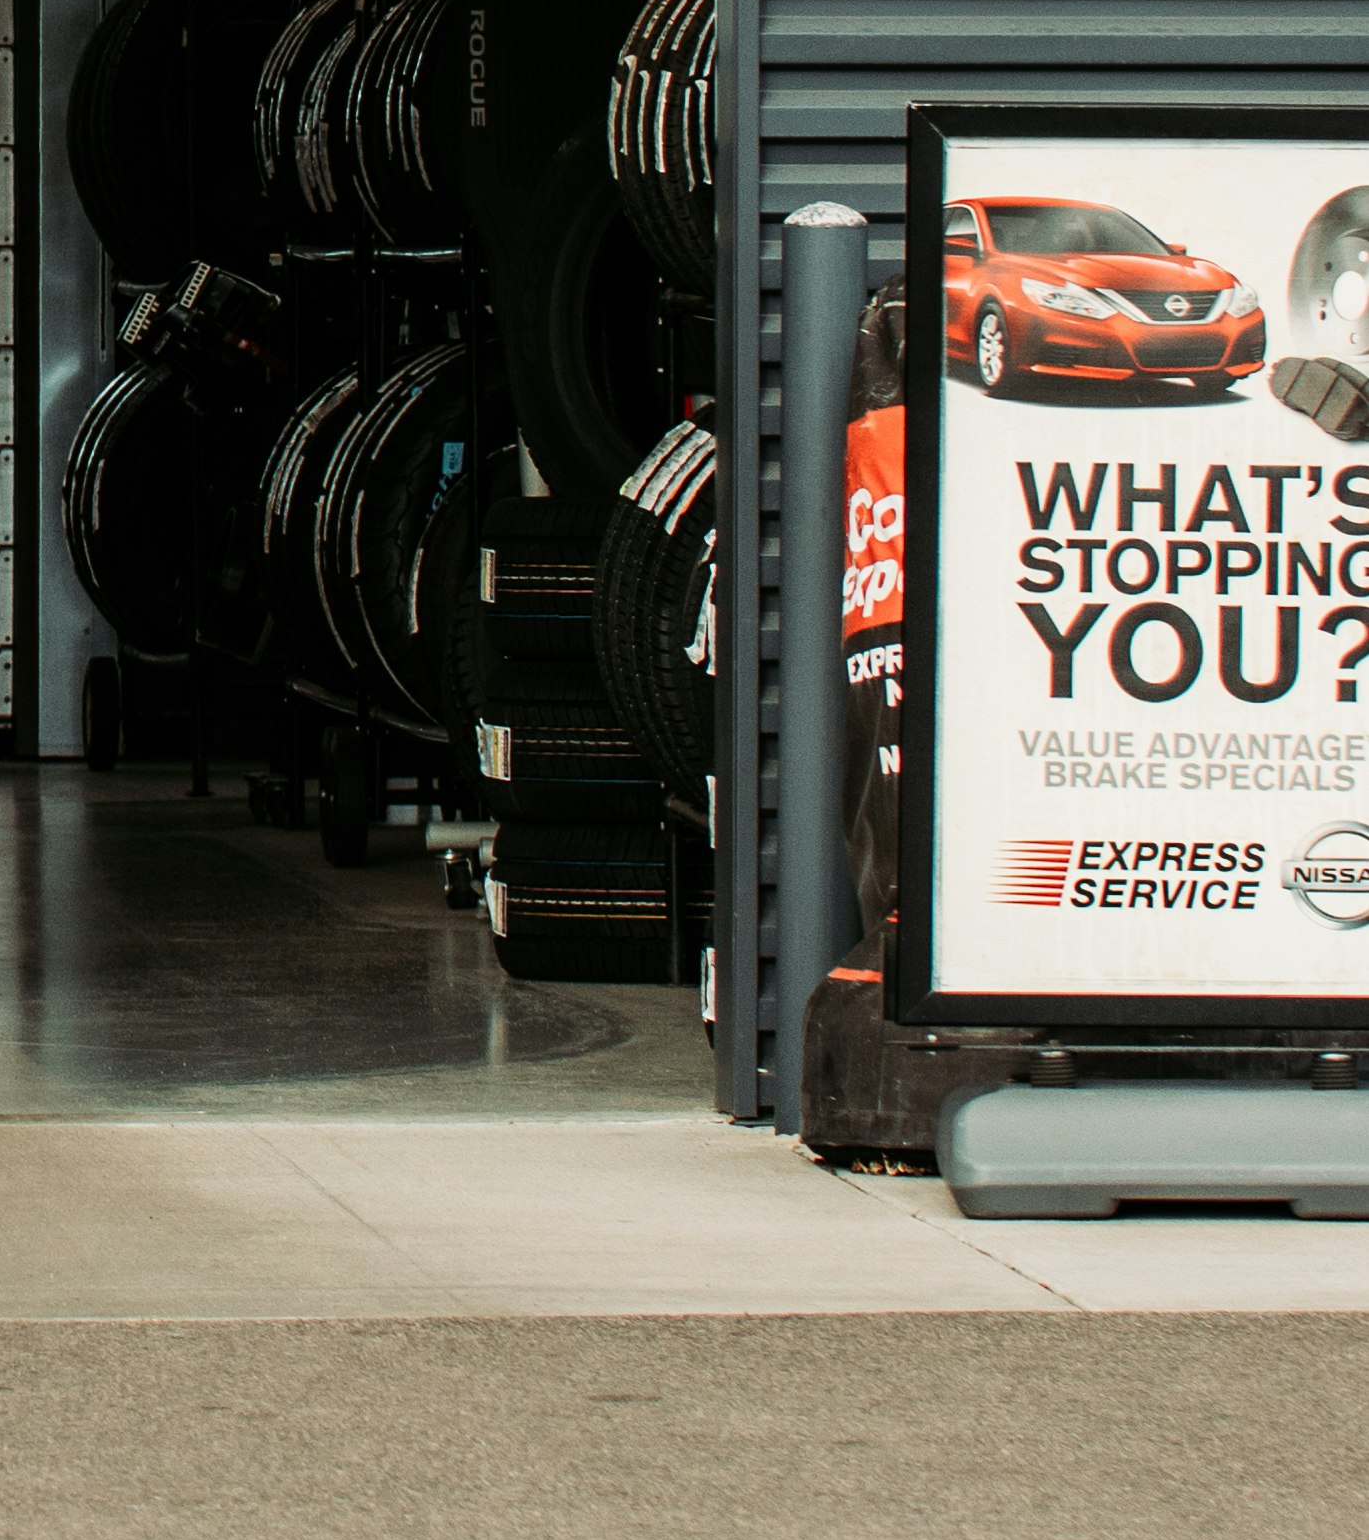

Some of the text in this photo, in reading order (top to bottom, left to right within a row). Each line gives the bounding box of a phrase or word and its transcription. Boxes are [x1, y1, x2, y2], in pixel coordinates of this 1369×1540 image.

[467, 8, 486, 128] ROGUE
[1015, 461, 1369, 535] WHAT'S
[1018, 730, 1134, 758] VALUE
[1044, 762, 1355, 792] BRAKE SPECIALS
[1077, 841, 1265, 872] EXPRESS
[1293, 866, 1369, 884] NISSA
[1070, 879, 1261, 910] SERVICE
